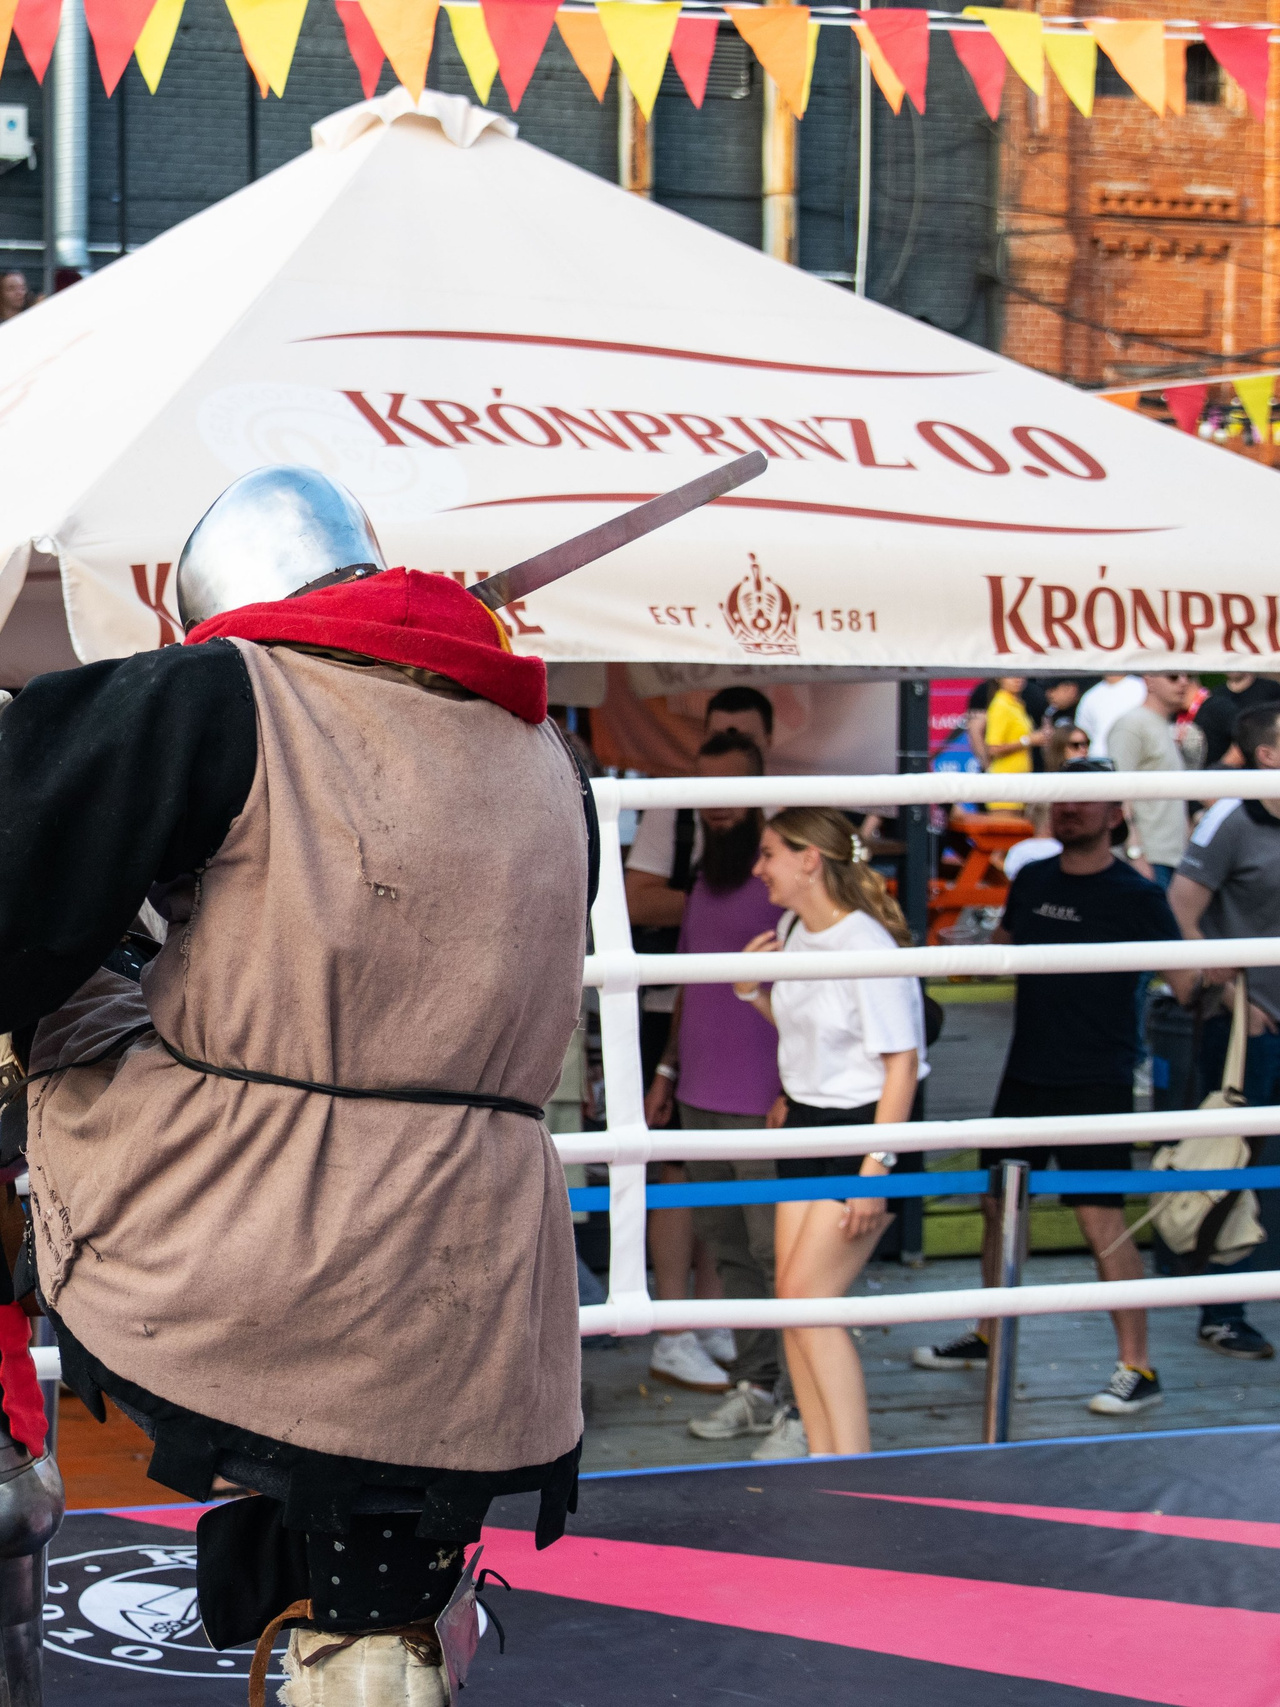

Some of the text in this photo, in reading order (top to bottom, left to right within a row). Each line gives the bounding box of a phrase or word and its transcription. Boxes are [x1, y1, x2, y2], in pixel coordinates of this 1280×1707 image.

[336, 387, 1108, 482] KRÓNPRINZ 0.0
[649, 605, 878, 633] EST. 1581
